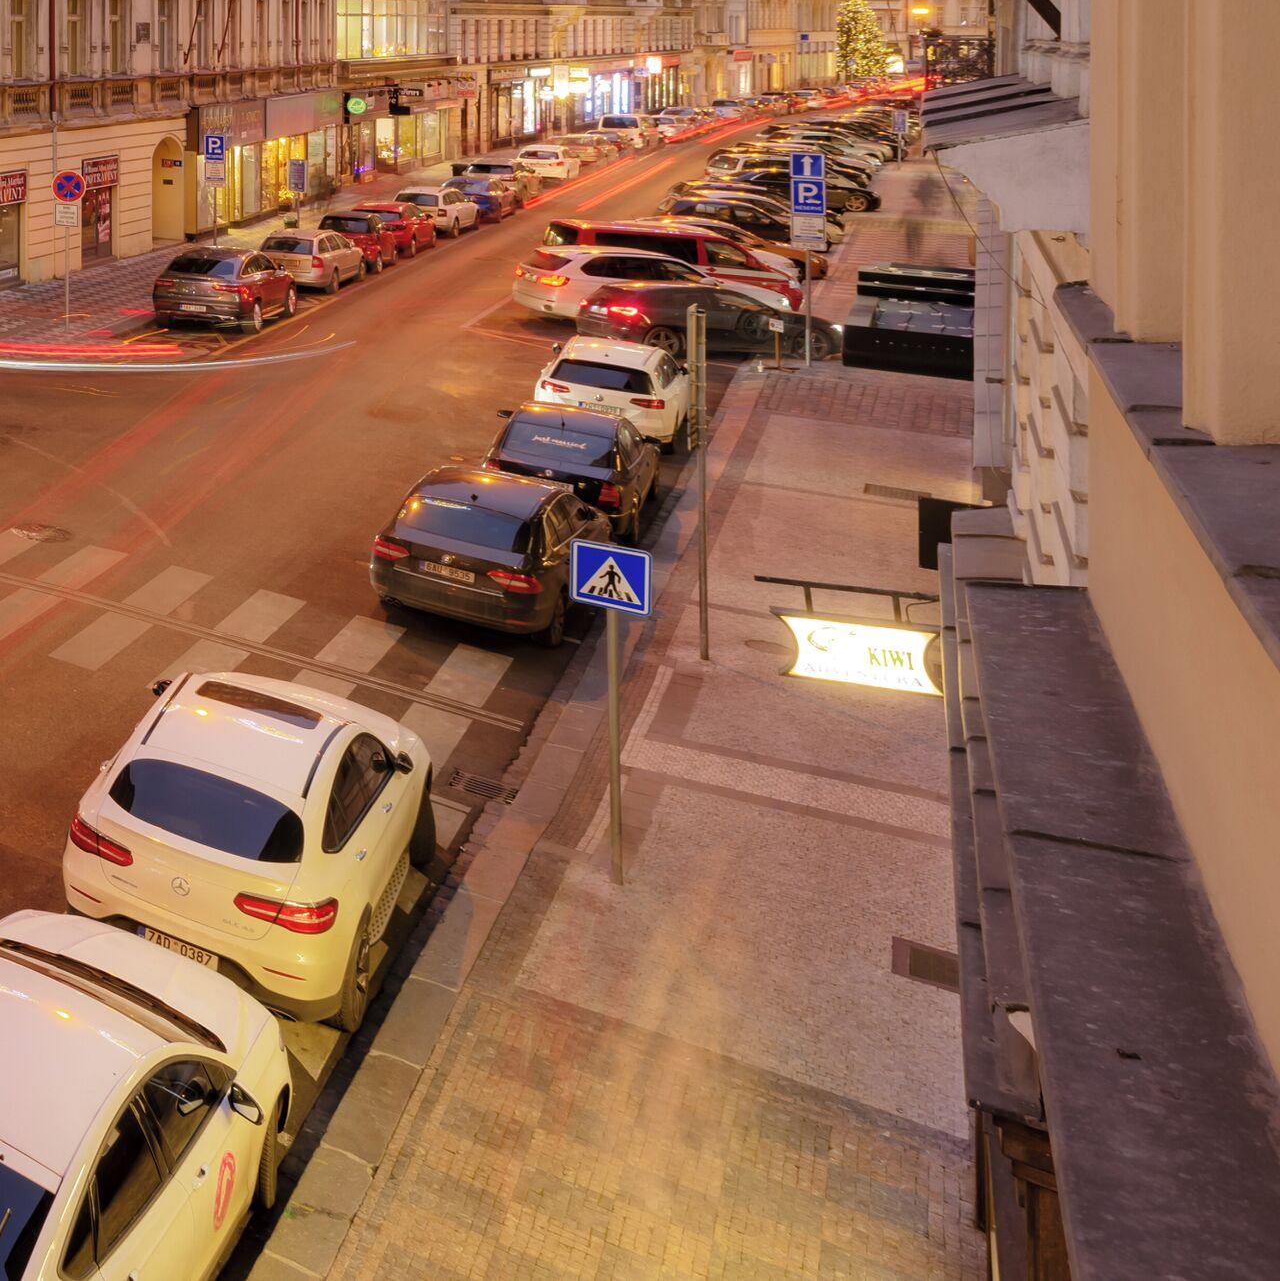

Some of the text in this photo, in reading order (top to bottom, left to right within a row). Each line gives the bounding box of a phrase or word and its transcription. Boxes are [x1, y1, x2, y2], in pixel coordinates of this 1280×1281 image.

[867, 646, 914, 671] KIWI
[147, 930, 213, 967] 7AD 0387
